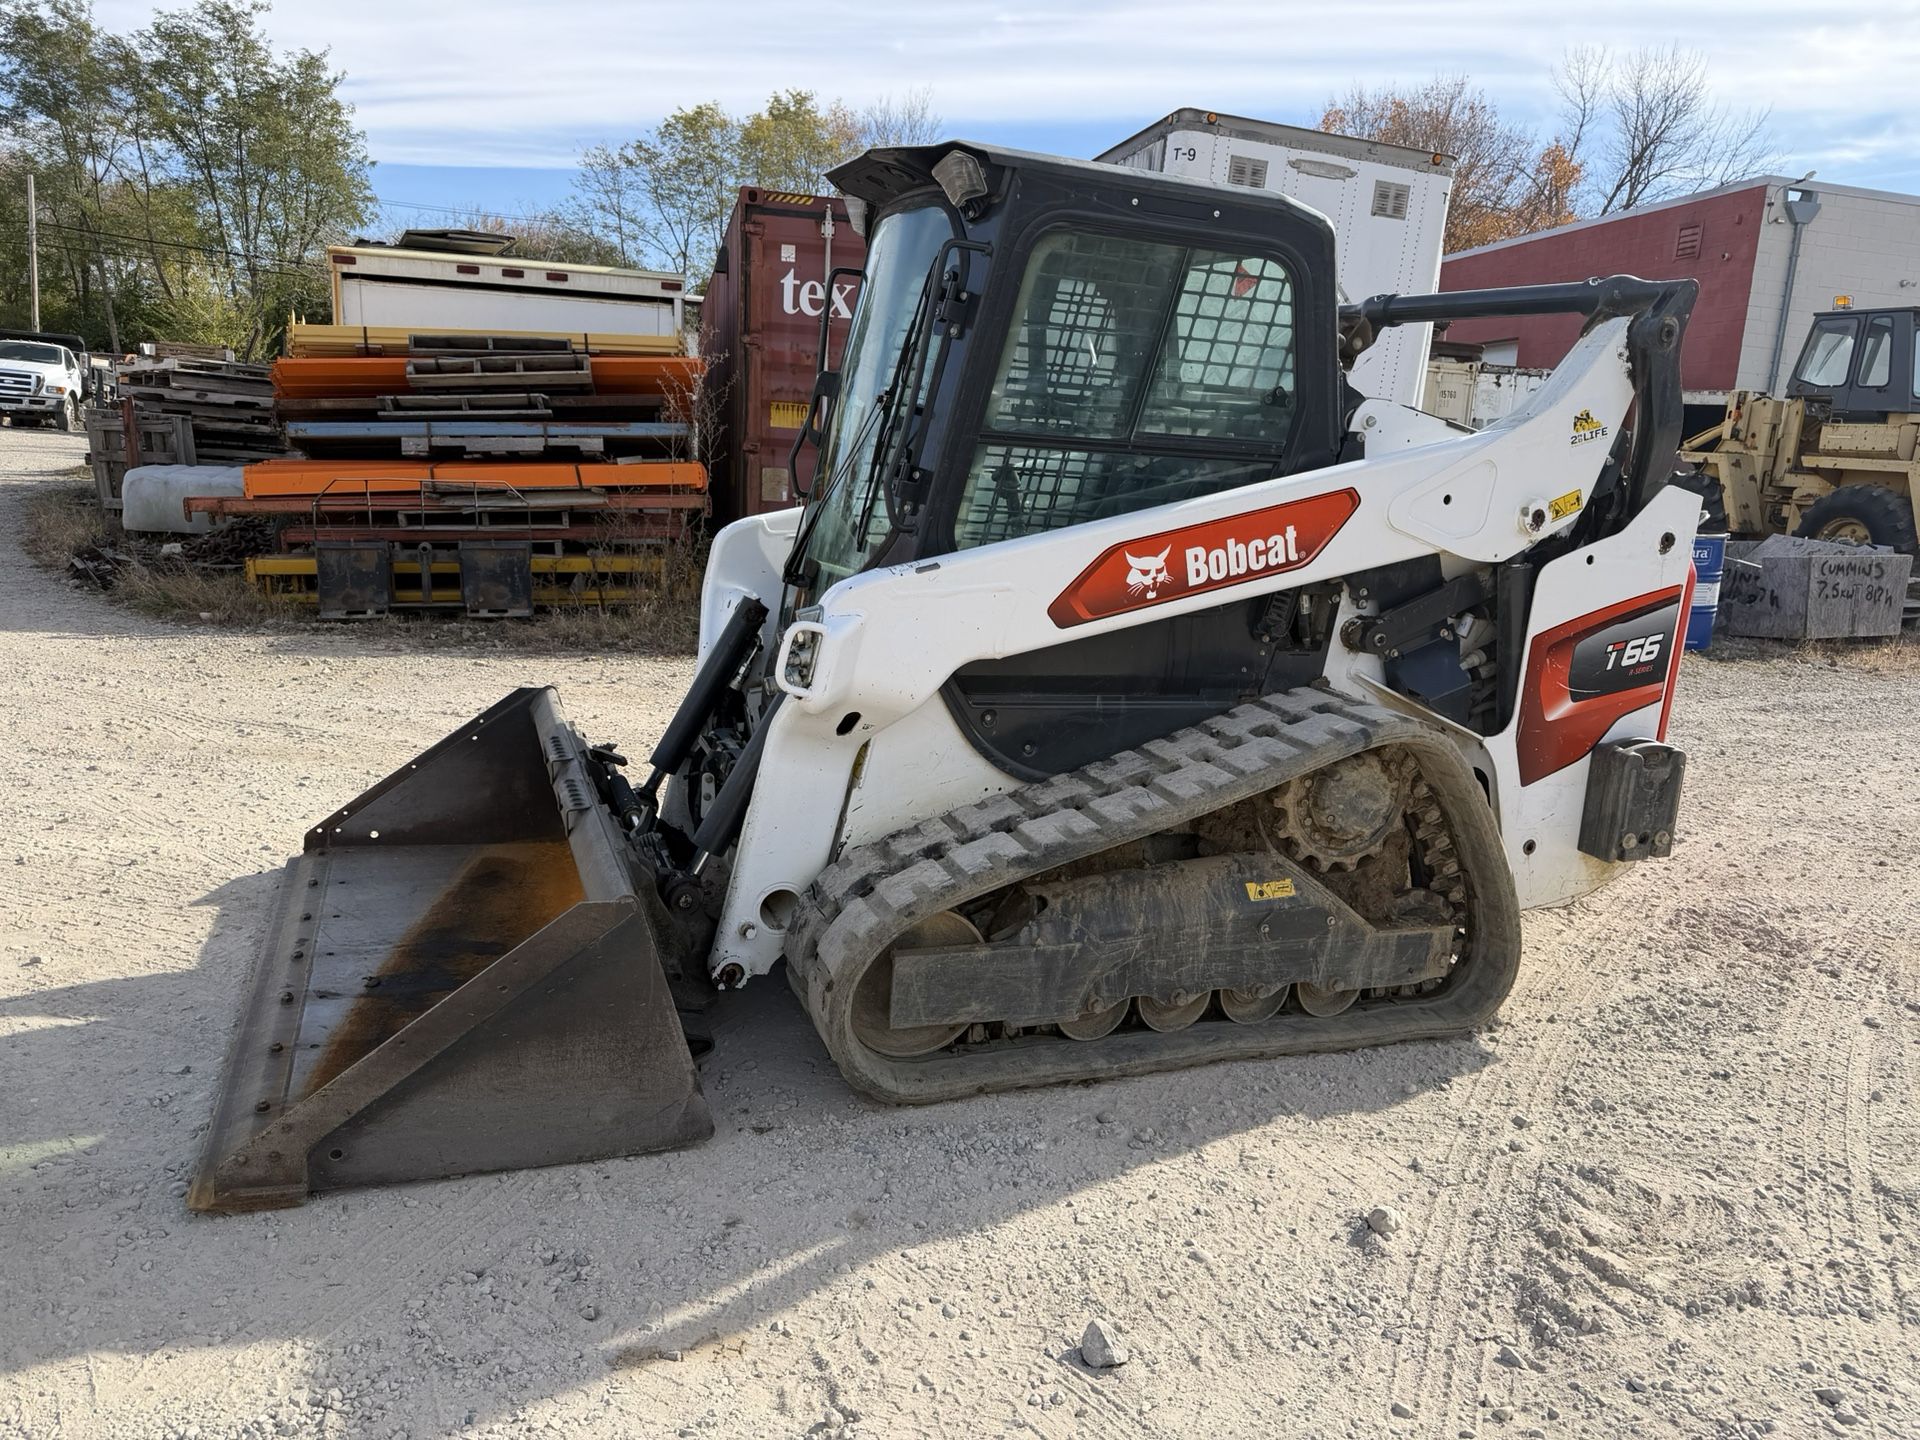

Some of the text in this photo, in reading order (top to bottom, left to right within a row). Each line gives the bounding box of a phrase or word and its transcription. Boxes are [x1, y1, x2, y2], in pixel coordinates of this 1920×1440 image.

[1174, 148, 1196, 161] T-9
[780, 268, 856, 319] tex
[1583, 426, 1608, 441] LIFE
[1185, 525, 1298, 587] Bobcat
[1820, 560, 1885, 579] CUMMINS
[1606, 633, 1665, 671] T66
